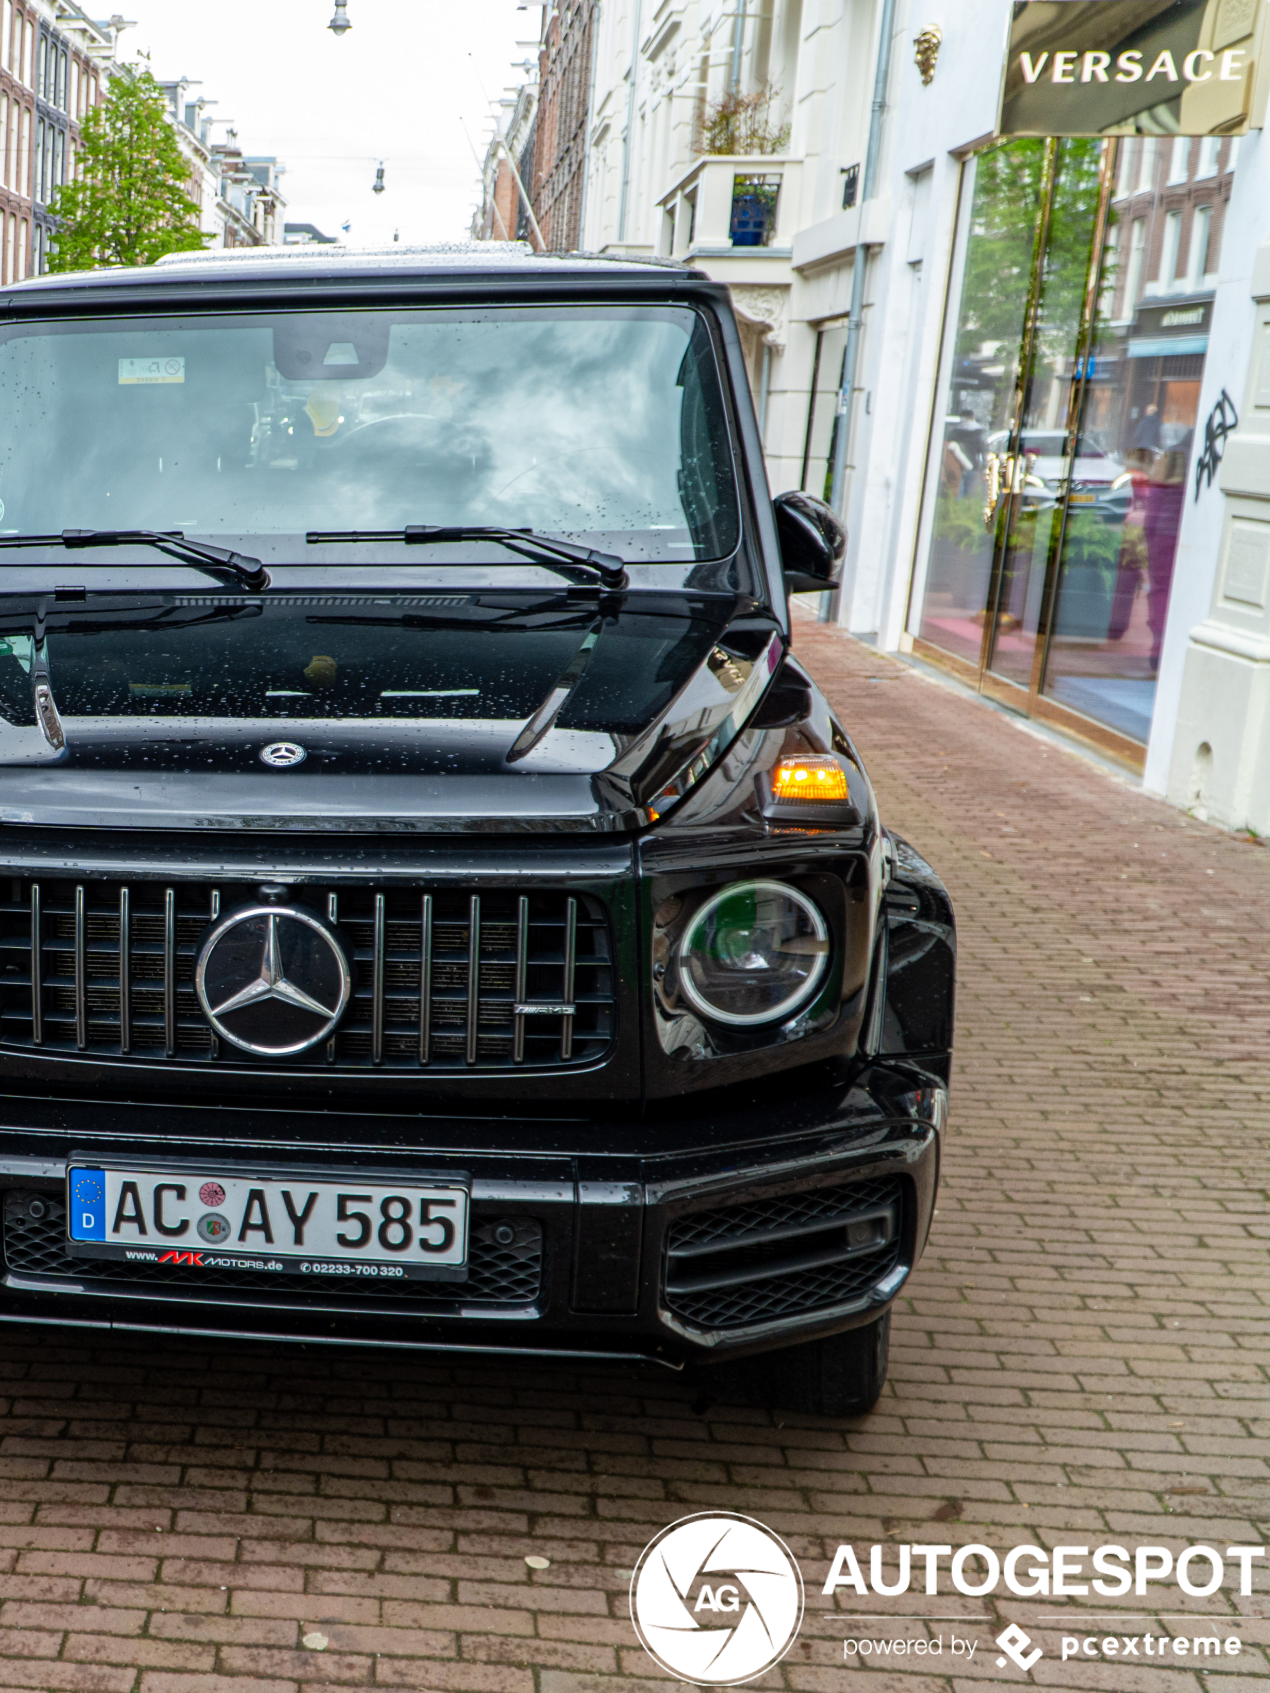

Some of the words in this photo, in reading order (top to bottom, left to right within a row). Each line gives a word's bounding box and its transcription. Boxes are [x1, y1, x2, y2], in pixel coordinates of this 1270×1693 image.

[1019, 49, 1246, 84] VERSACE
[82, 1212, 95, 1229] D
[112, 1180, 190, 1237] AC
[238, 1188, 319, 1246] AY
[336, 1193, 457, 1254] 585
